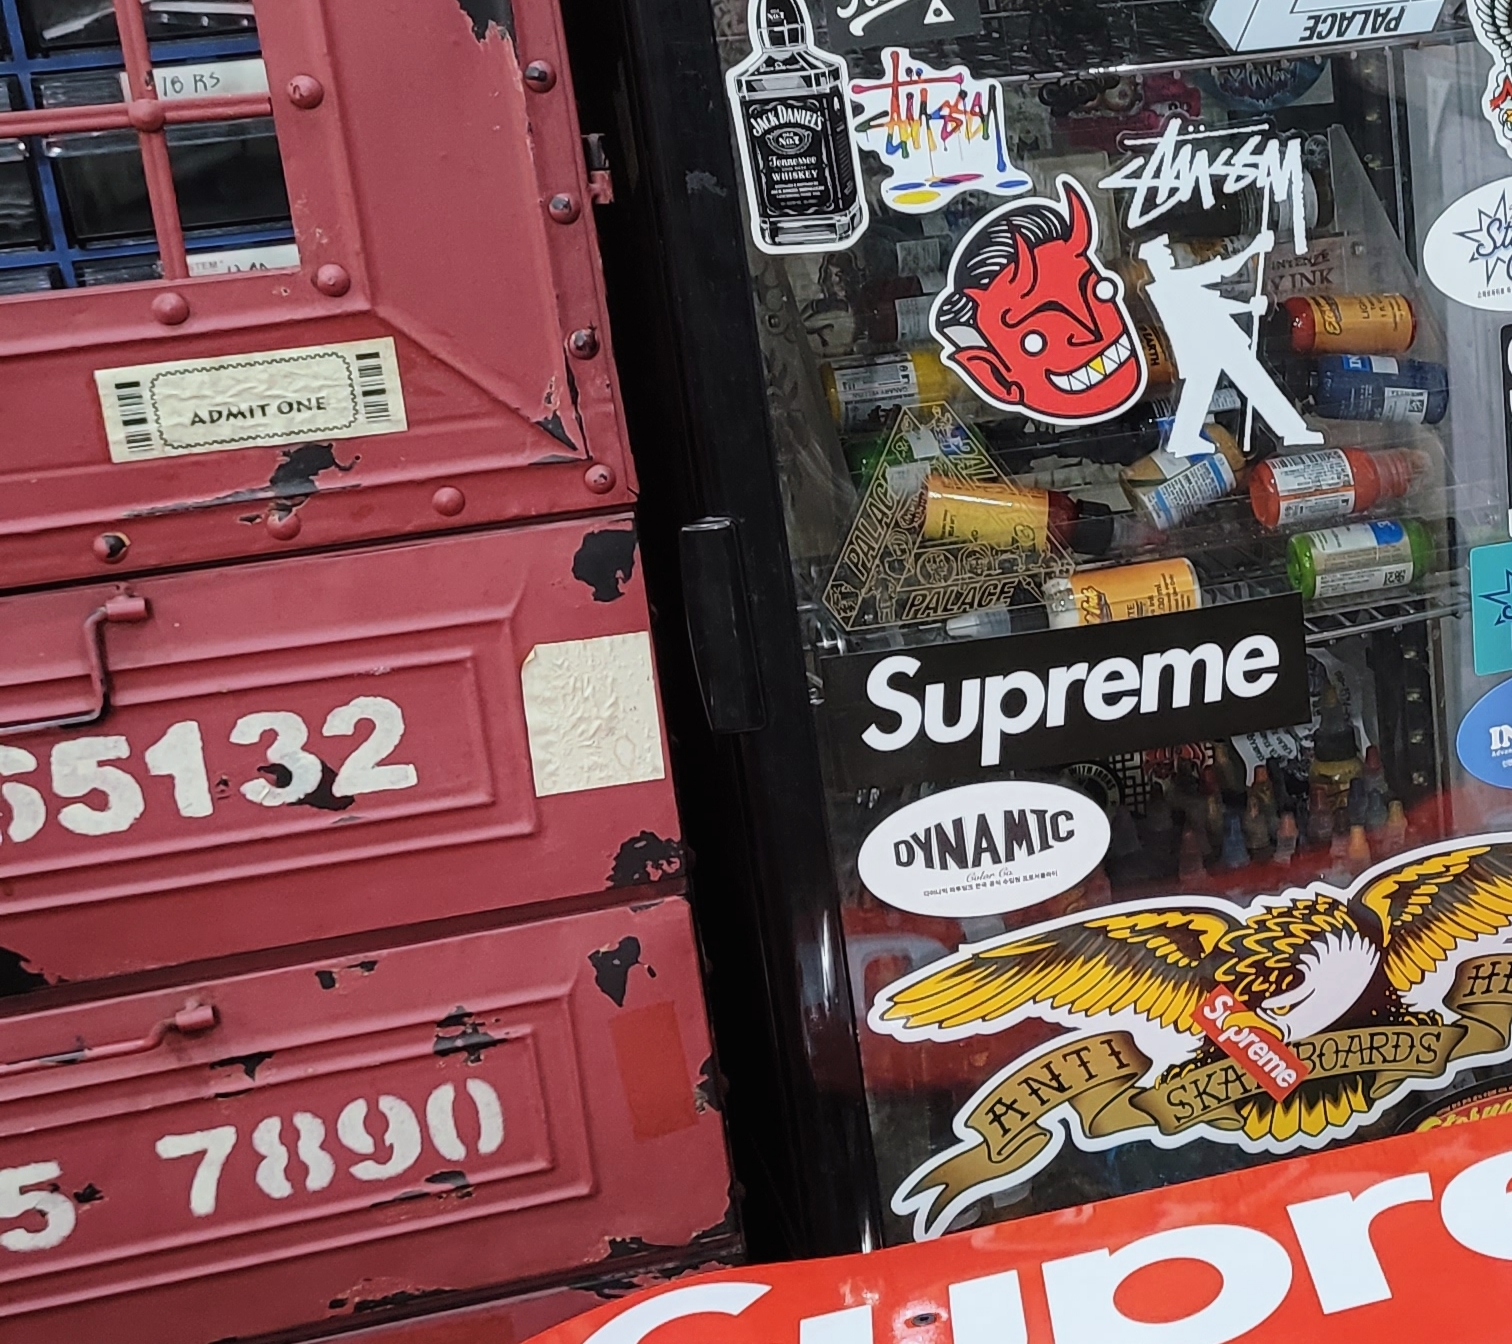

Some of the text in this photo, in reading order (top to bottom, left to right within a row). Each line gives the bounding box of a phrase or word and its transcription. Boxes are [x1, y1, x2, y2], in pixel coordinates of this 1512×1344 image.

[1298, 6, 1408, 42] PALACE
[192, 71, 221, 94] RS
[749, 104, 825, 137] JACK DANIEL'S
[771, 169, 819, 182] WHISKEY
[1289, 267, 1335, 291] INK
[189, 394, 328, 428] ADMIT ONE
[901, 578, 1020, 621] PALACE
[861, 633, 1282, 768] Supreme
[891, 806, 1076, 872] DYNAMIC
[984, 1028, 1442, 1140] ANTI SKABOARDS
[155, 1077, 504, 1218] 7890
